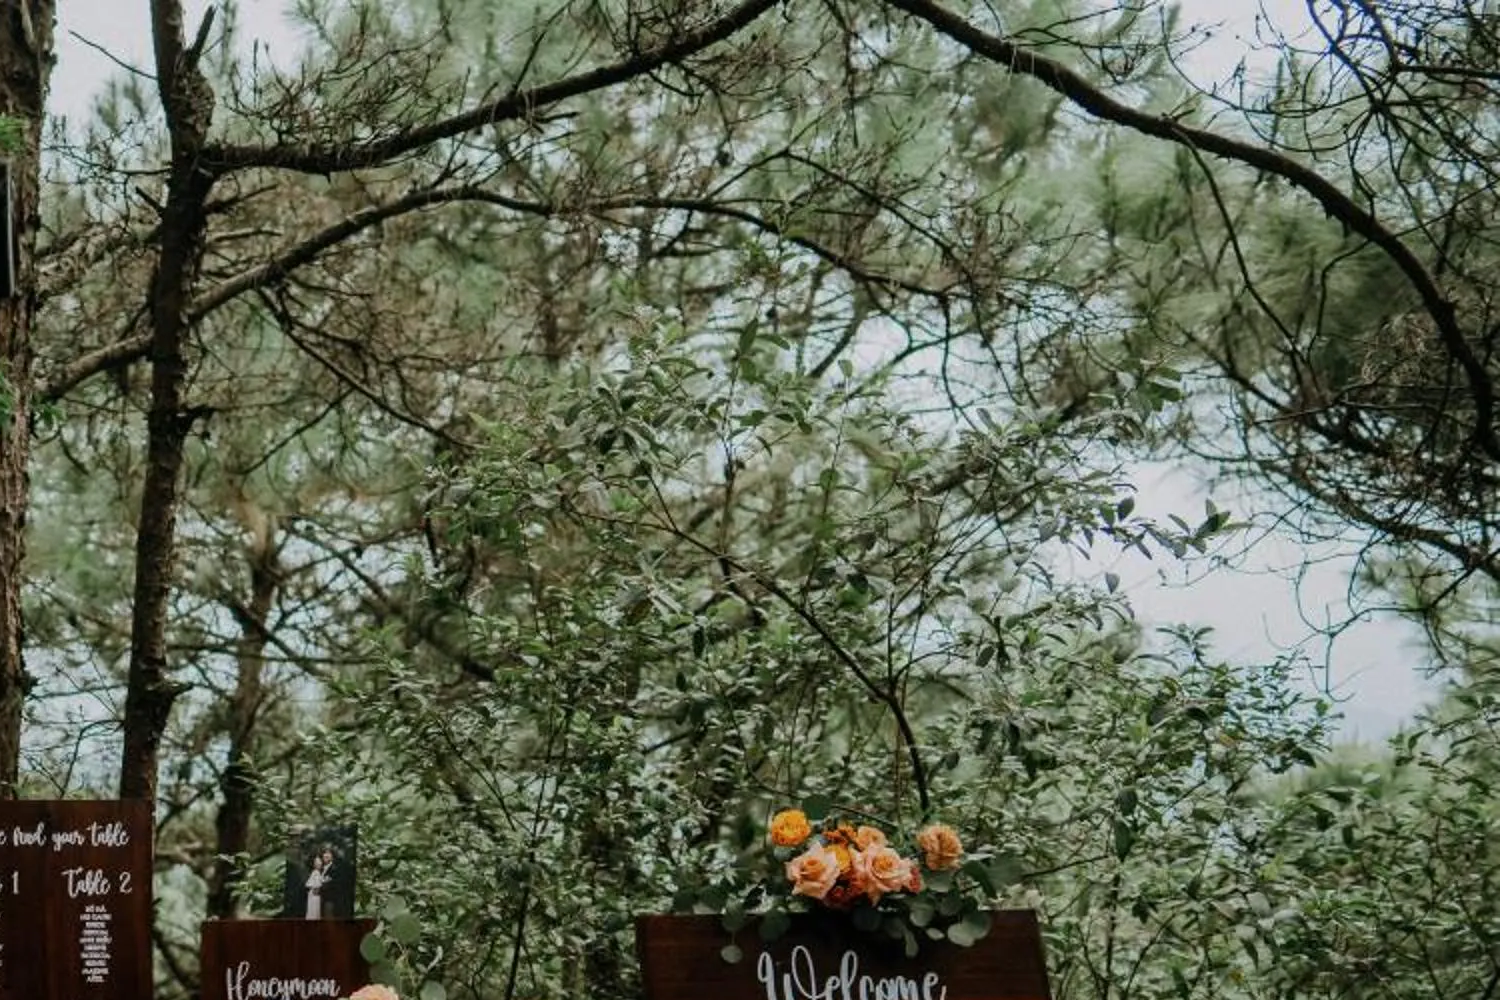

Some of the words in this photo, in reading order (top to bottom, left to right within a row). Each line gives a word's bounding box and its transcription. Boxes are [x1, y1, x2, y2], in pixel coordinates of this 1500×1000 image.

[51, 830, 85, 852] your
[86, 819, 130, 847] table
[11, 871, 20, 895] 1
[61, 866, 111, 898] Table
[118, 871, 133, 894] 2
